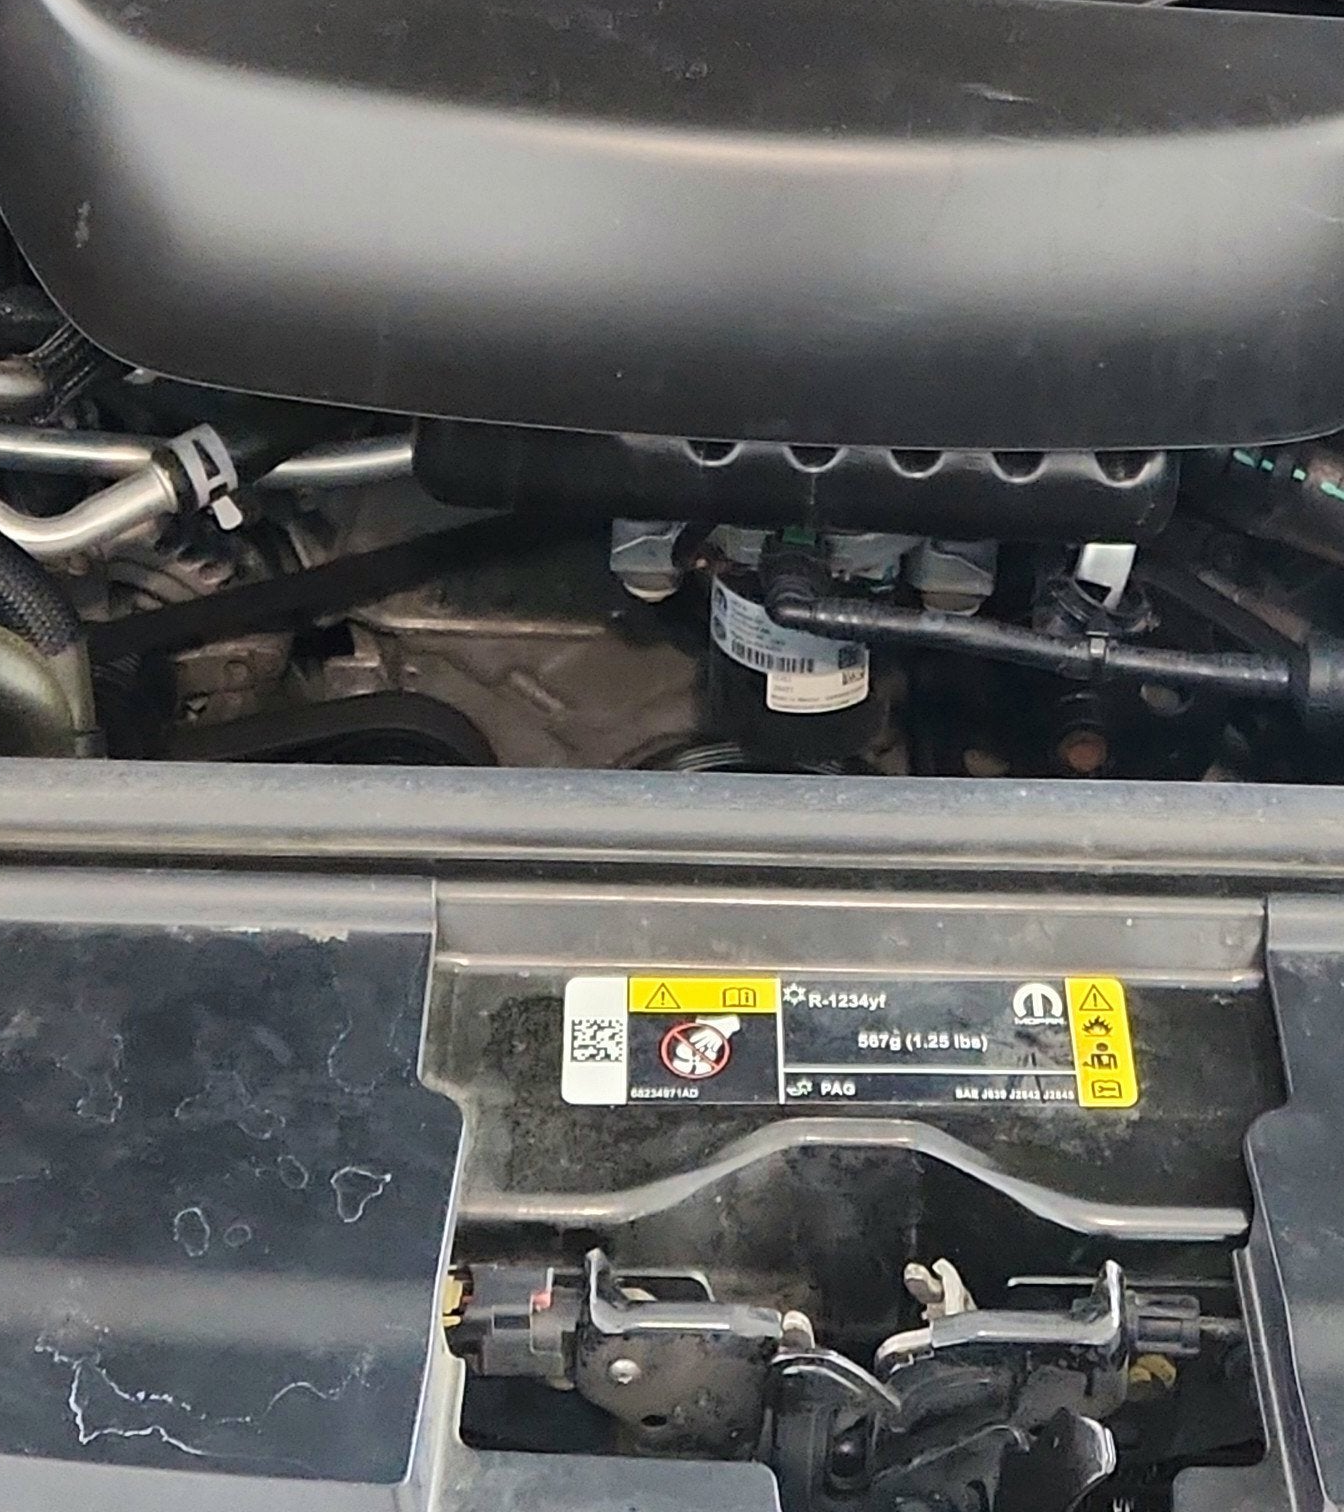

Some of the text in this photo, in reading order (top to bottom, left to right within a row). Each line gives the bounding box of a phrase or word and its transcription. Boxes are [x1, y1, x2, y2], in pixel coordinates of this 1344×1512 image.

[808, 992, 887, 1011] R-1234yf
[857, 1032, 988, 1053] 567g (1.25 lbs)
[820, 1082, 857, 1096] PAG
